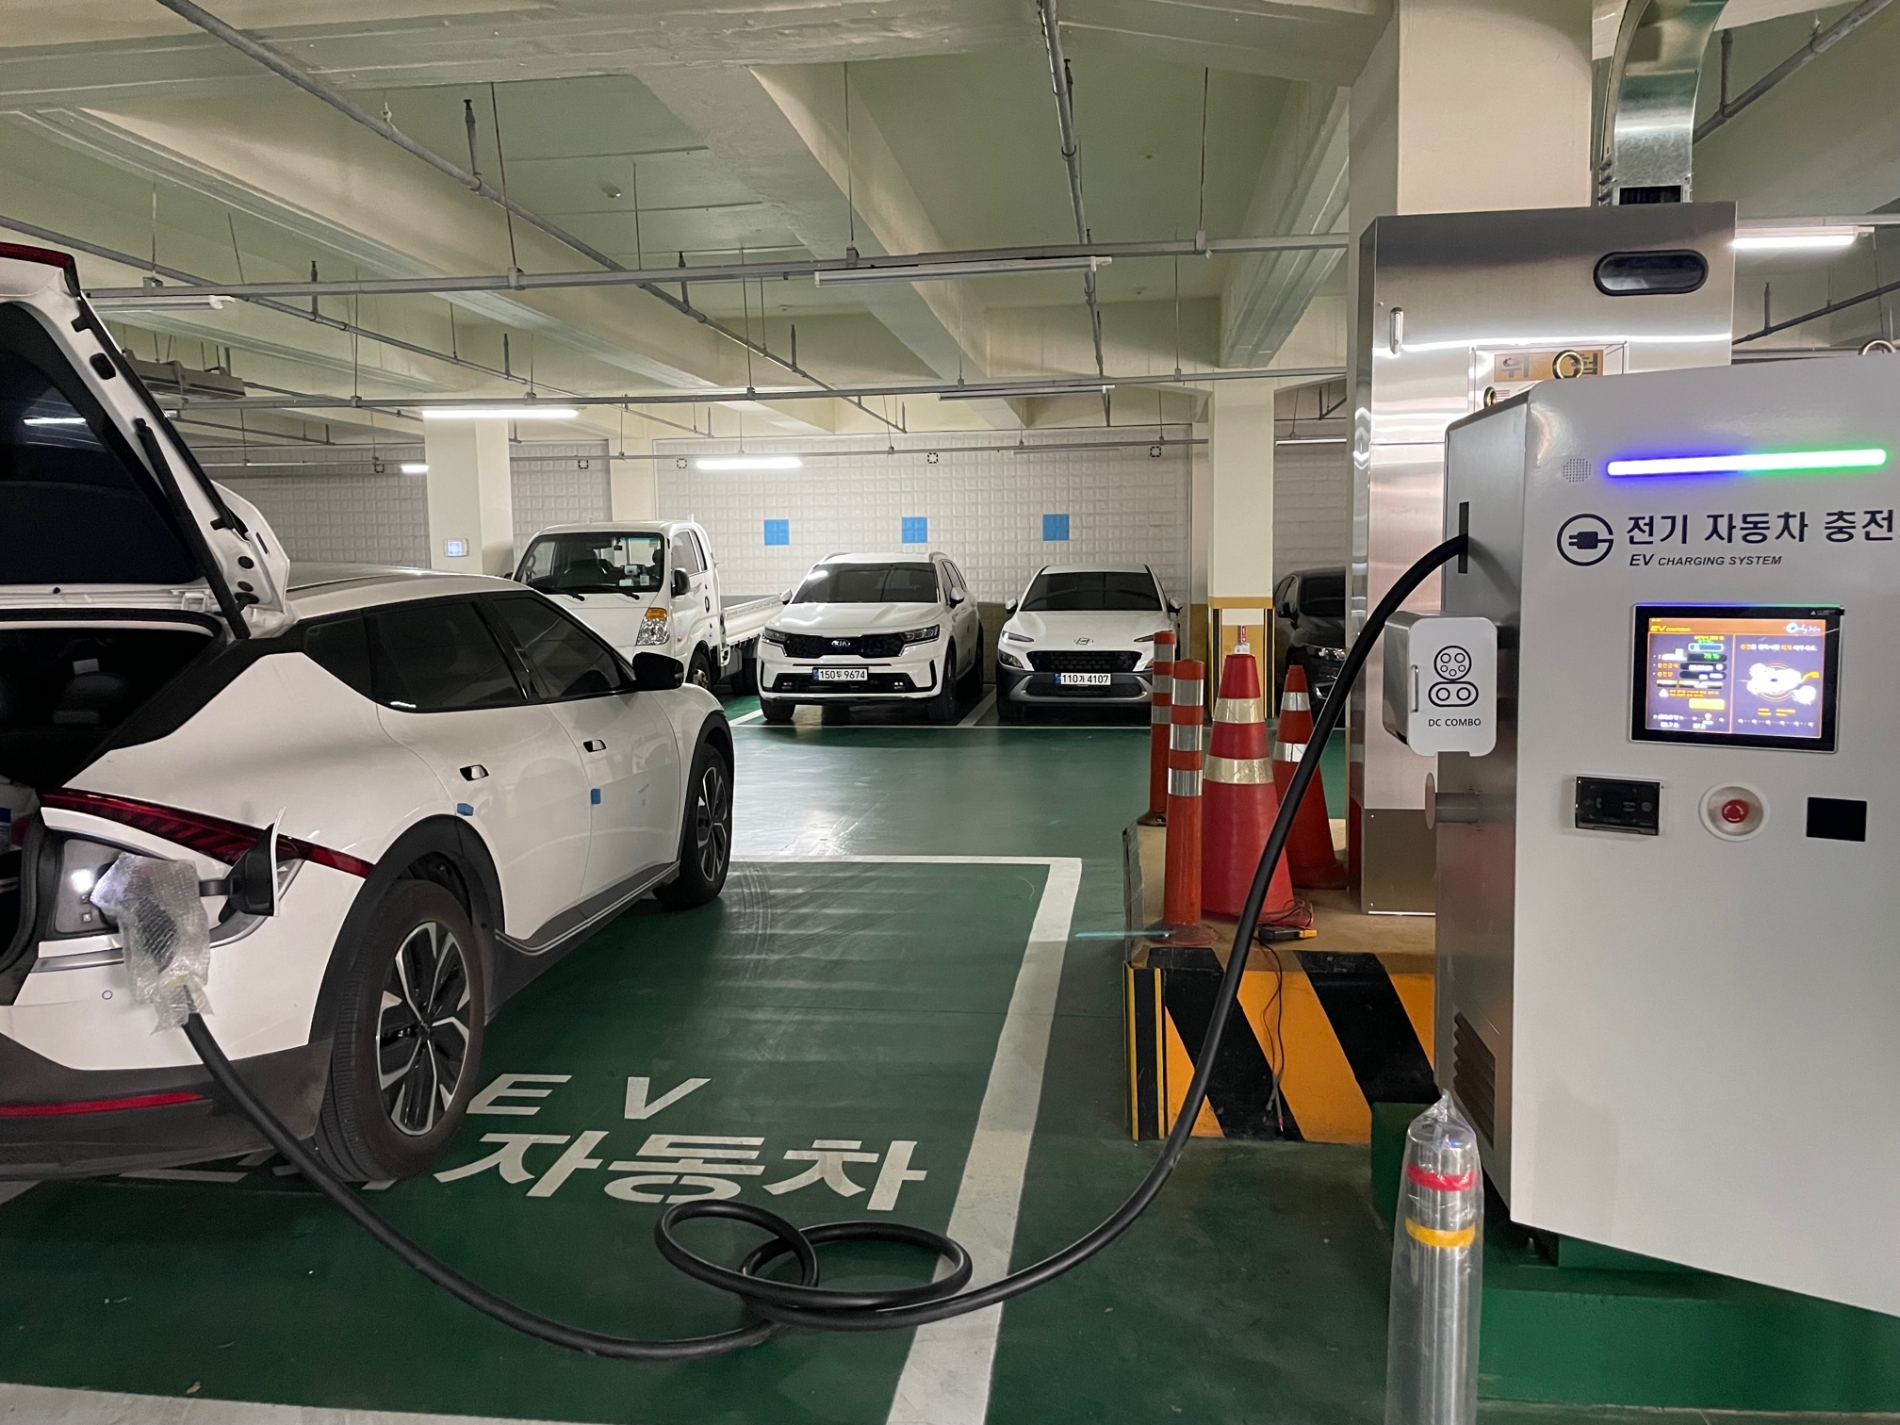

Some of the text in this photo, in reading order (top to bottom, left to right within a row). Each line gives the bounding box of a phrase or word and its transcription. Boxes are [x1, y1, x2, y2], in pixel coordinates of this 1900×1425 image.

[1626, 509, 1893, 545] 전기 자동차 충전
[1629, 553, 1782, 566] EV CHARGING SYSTEM
[844, 670, 865, 679] 9674
[1087, 674, 1109, 683] 4107
[1428, 718, 1482, 727] DC COMBO
[433, 1130, 927, 1211] 자동차
